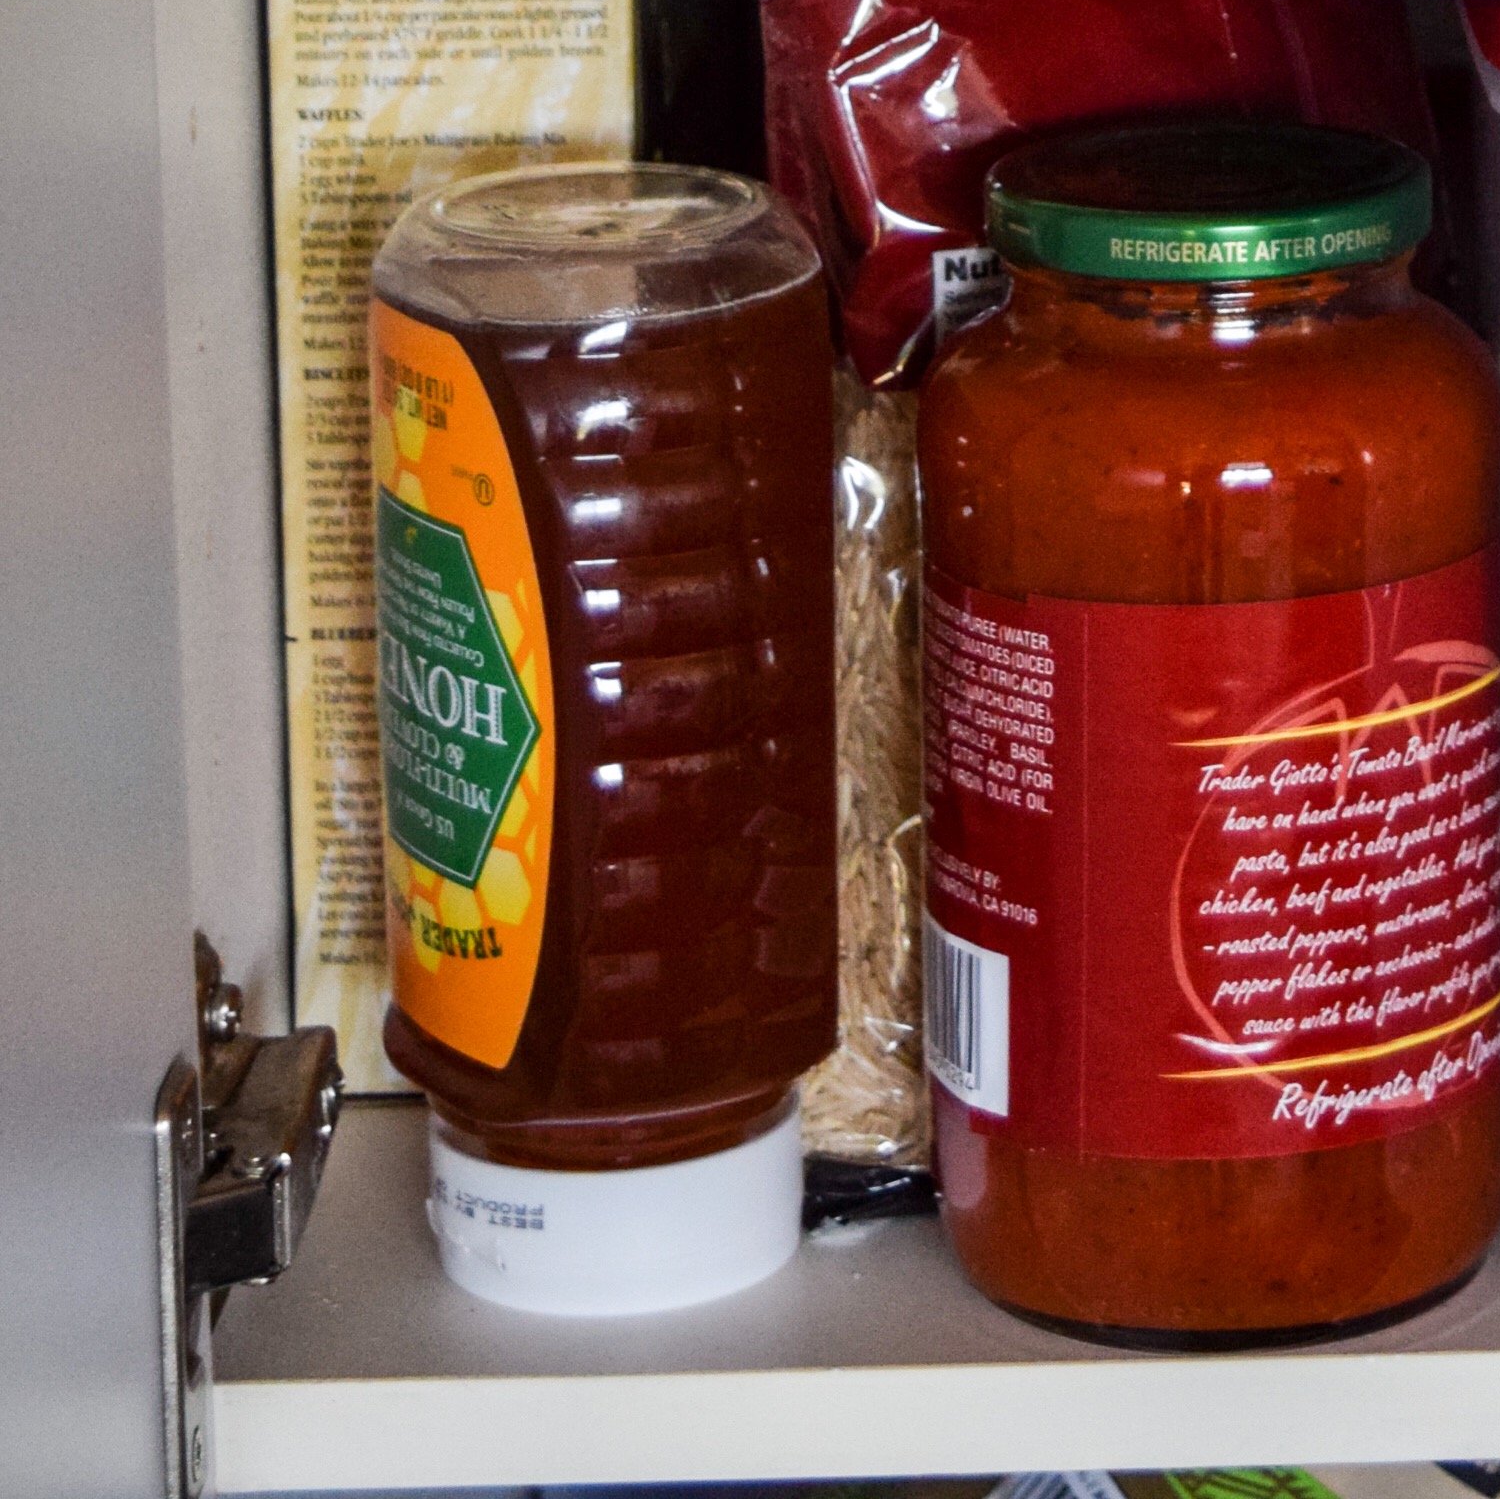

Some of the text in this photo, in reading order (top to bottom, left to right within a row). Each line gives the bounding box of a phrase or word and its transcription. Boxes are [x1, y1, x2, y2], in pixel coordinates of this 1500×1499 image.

[1110, 224, 1391, 263] REFRIGERATE AFTER OPENING
[1199, 764, 1264, 792] Trader
[1270, 753, 1342, 794] Giotto's
[1347, 747, 1401, 778] Tomato
[1200, 888, 1278, 916] chicken,
[1286, 878, 1332, 914] beef
[1332, 874, 1367, 902] and
[421, 914, 503, 960] TRADER
[1273, 1050, 1464, 1128] Refrigerate after
